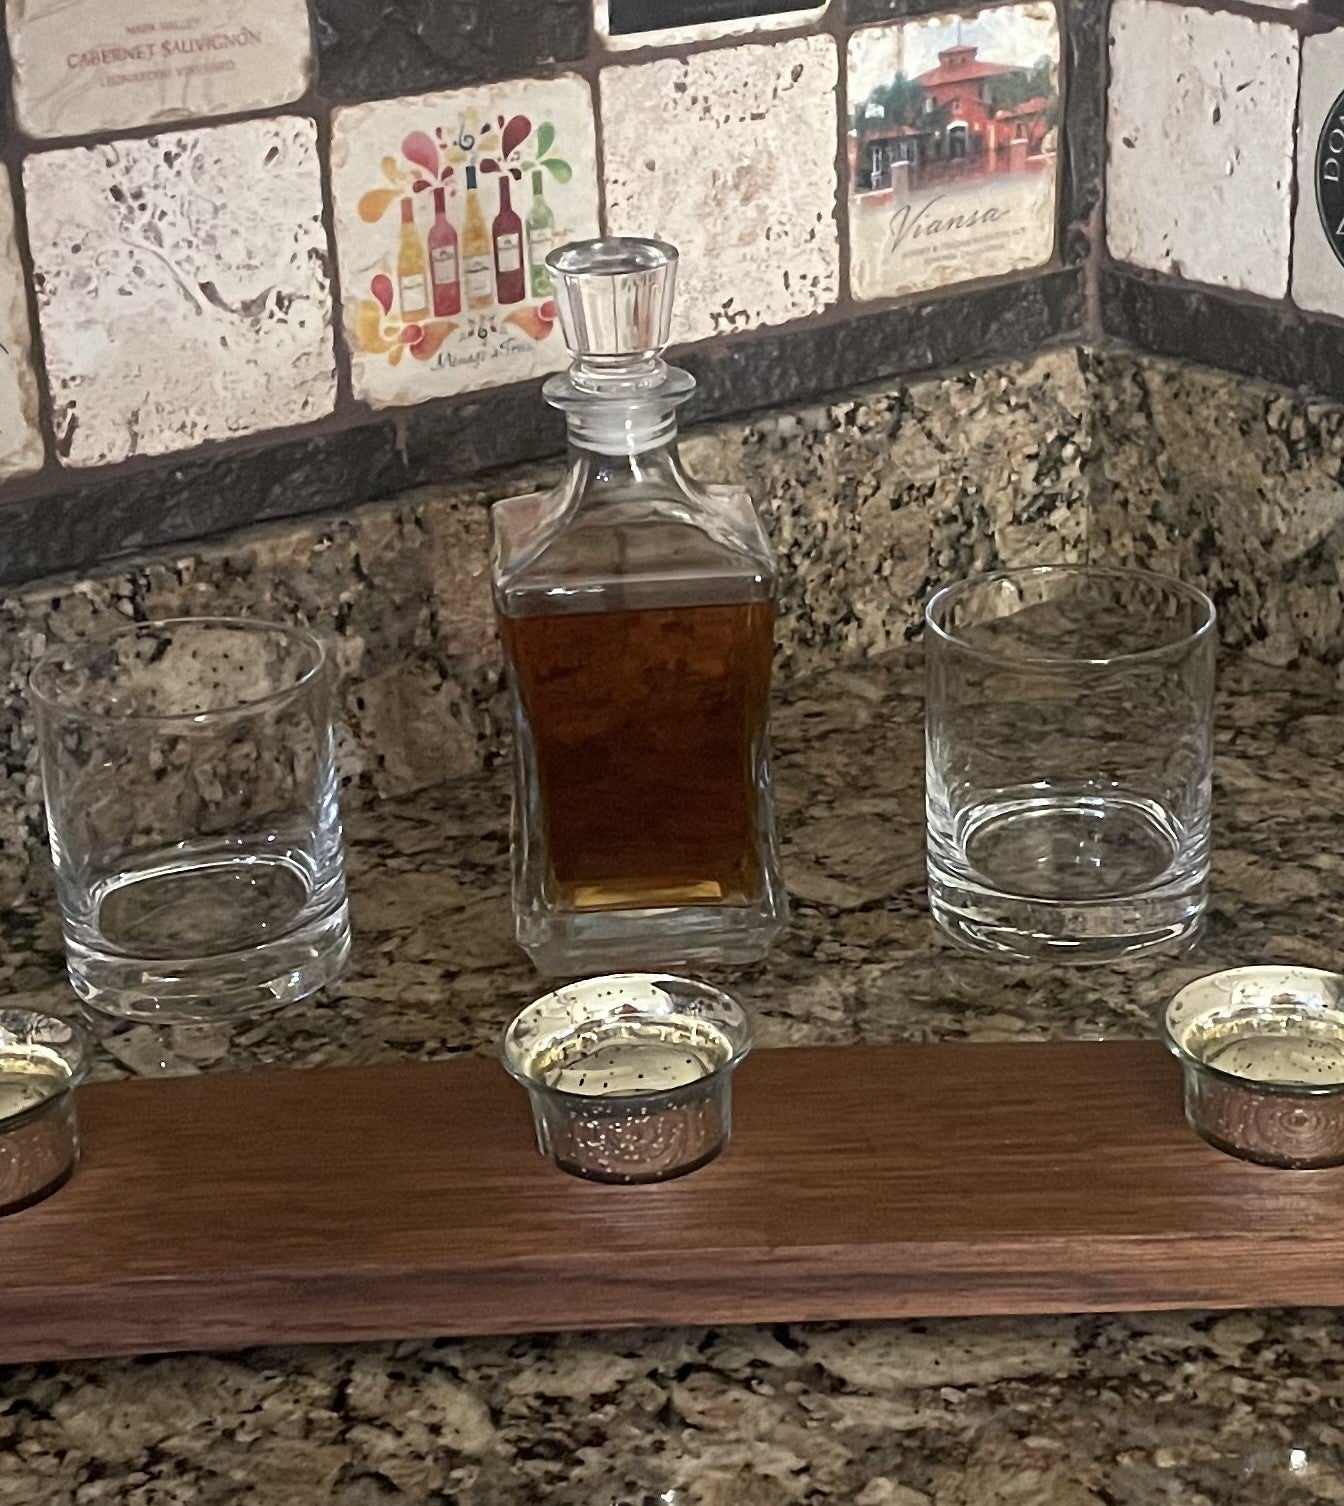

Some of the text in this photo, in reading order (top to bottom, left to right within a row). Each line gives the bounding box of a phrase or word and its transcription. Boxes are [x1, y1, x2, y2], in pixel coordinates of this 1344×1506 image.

[66, 26, 262, 69] CABERNET SAUVIGNON
[889, 194, 1010, 254] Viansa
